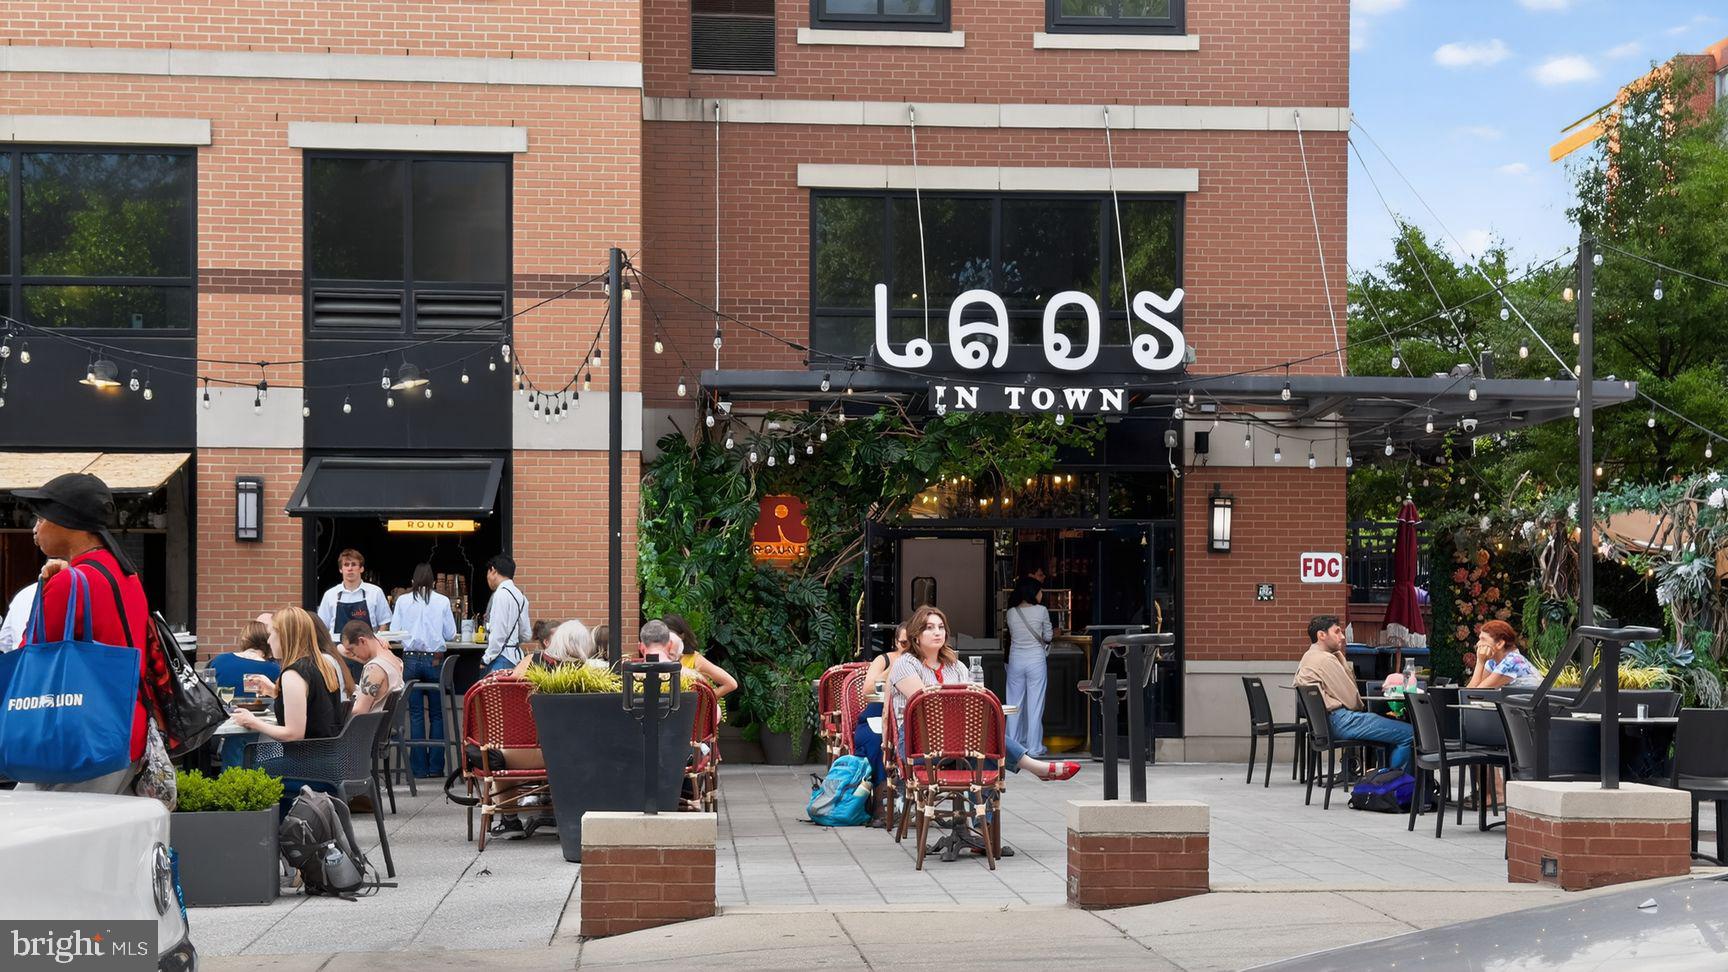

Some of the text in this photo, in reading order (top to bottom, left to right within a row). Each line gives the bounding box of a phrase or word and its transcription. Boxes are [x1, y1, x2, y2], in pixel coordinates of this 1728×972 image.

[934, 385, 1125, 411] IN TOWN
[407, 521, 454, 529] ROUND
[751, 544, 807, 556] ROUND
[1302, 557, 1340, 578] FDC
[7, 693, 83, 712] FOOD LION
